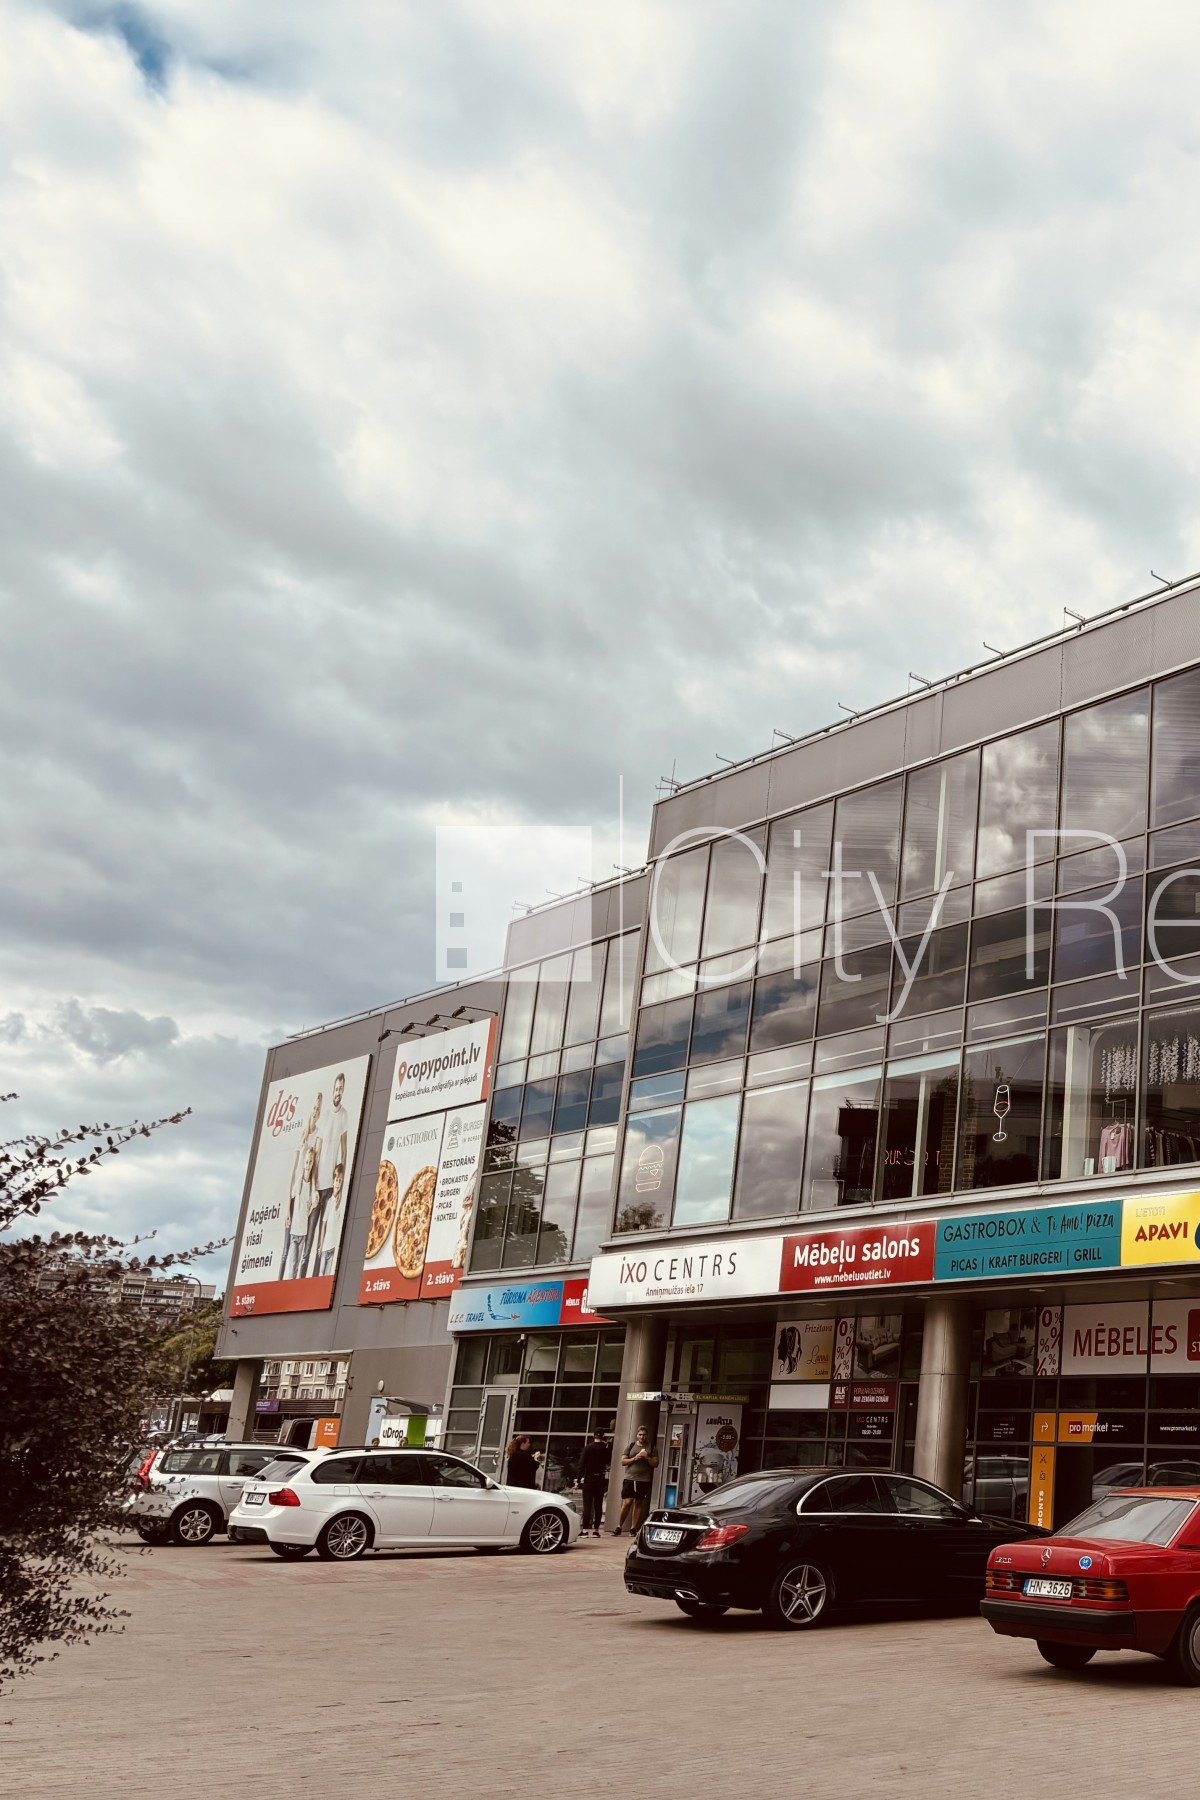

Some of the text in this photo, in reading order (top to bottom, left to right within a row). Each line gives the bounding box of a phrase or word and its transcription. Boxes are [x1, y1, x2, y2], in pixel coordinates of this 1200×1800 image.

[406, 1042, 481, 1082] copypoint.lv
[267, 1090, 299, 1137] dgs
[396, 1128, 439, 1149] GASTROBOX
[442, 1155, 476, 1169] RESTORĀNS
[441, 1174, 469, 1186] BROKASTIS
[440, 1188, 461, 1198] BURGERI
[249, 1203, 281, 1225] Apģērbi
[438, 1201, 453, 1210] PICAS
[943, 1217, 1026, 1242] GASTROBOX
[1030, 1216, 1041, 1234] &
[1086, 1212, 1116, 1233] pizza
[1134, 1221, 1189, 1243] APAVI
[246, 1230, 263, 1247] visai
[793, 1235, 920, 1272] Mēbeļu salons
[951, 1248, 1102, 1272] PICAS KRAFT BURGERI GRILL
[241, 1253, 273, 1274] ģimenei
[654, 1252, 737, 1281] CENTRS
[427, 1273, 455, 1286] 2. stāvs
[814, 1268, 892, 1285] www.mebeluoutlet.lv
[365, 1280, 391, 1292] 2. stāvs
[697, 1283, 704, 1293] 17
[235, 1294, 256, 1306] 3. stāvs
[466, 1312, 485, 1323] TRAVEL
[1072, 1322, 1178, 1357] MĒBELES
[1069, 1423, 1081, 1434] pro
[1082, 1422, 1109, 1432] market
[1037, 1490, 1045, 1527] MONTS
[1029, 1580, 1070, 1596] HN-3626
